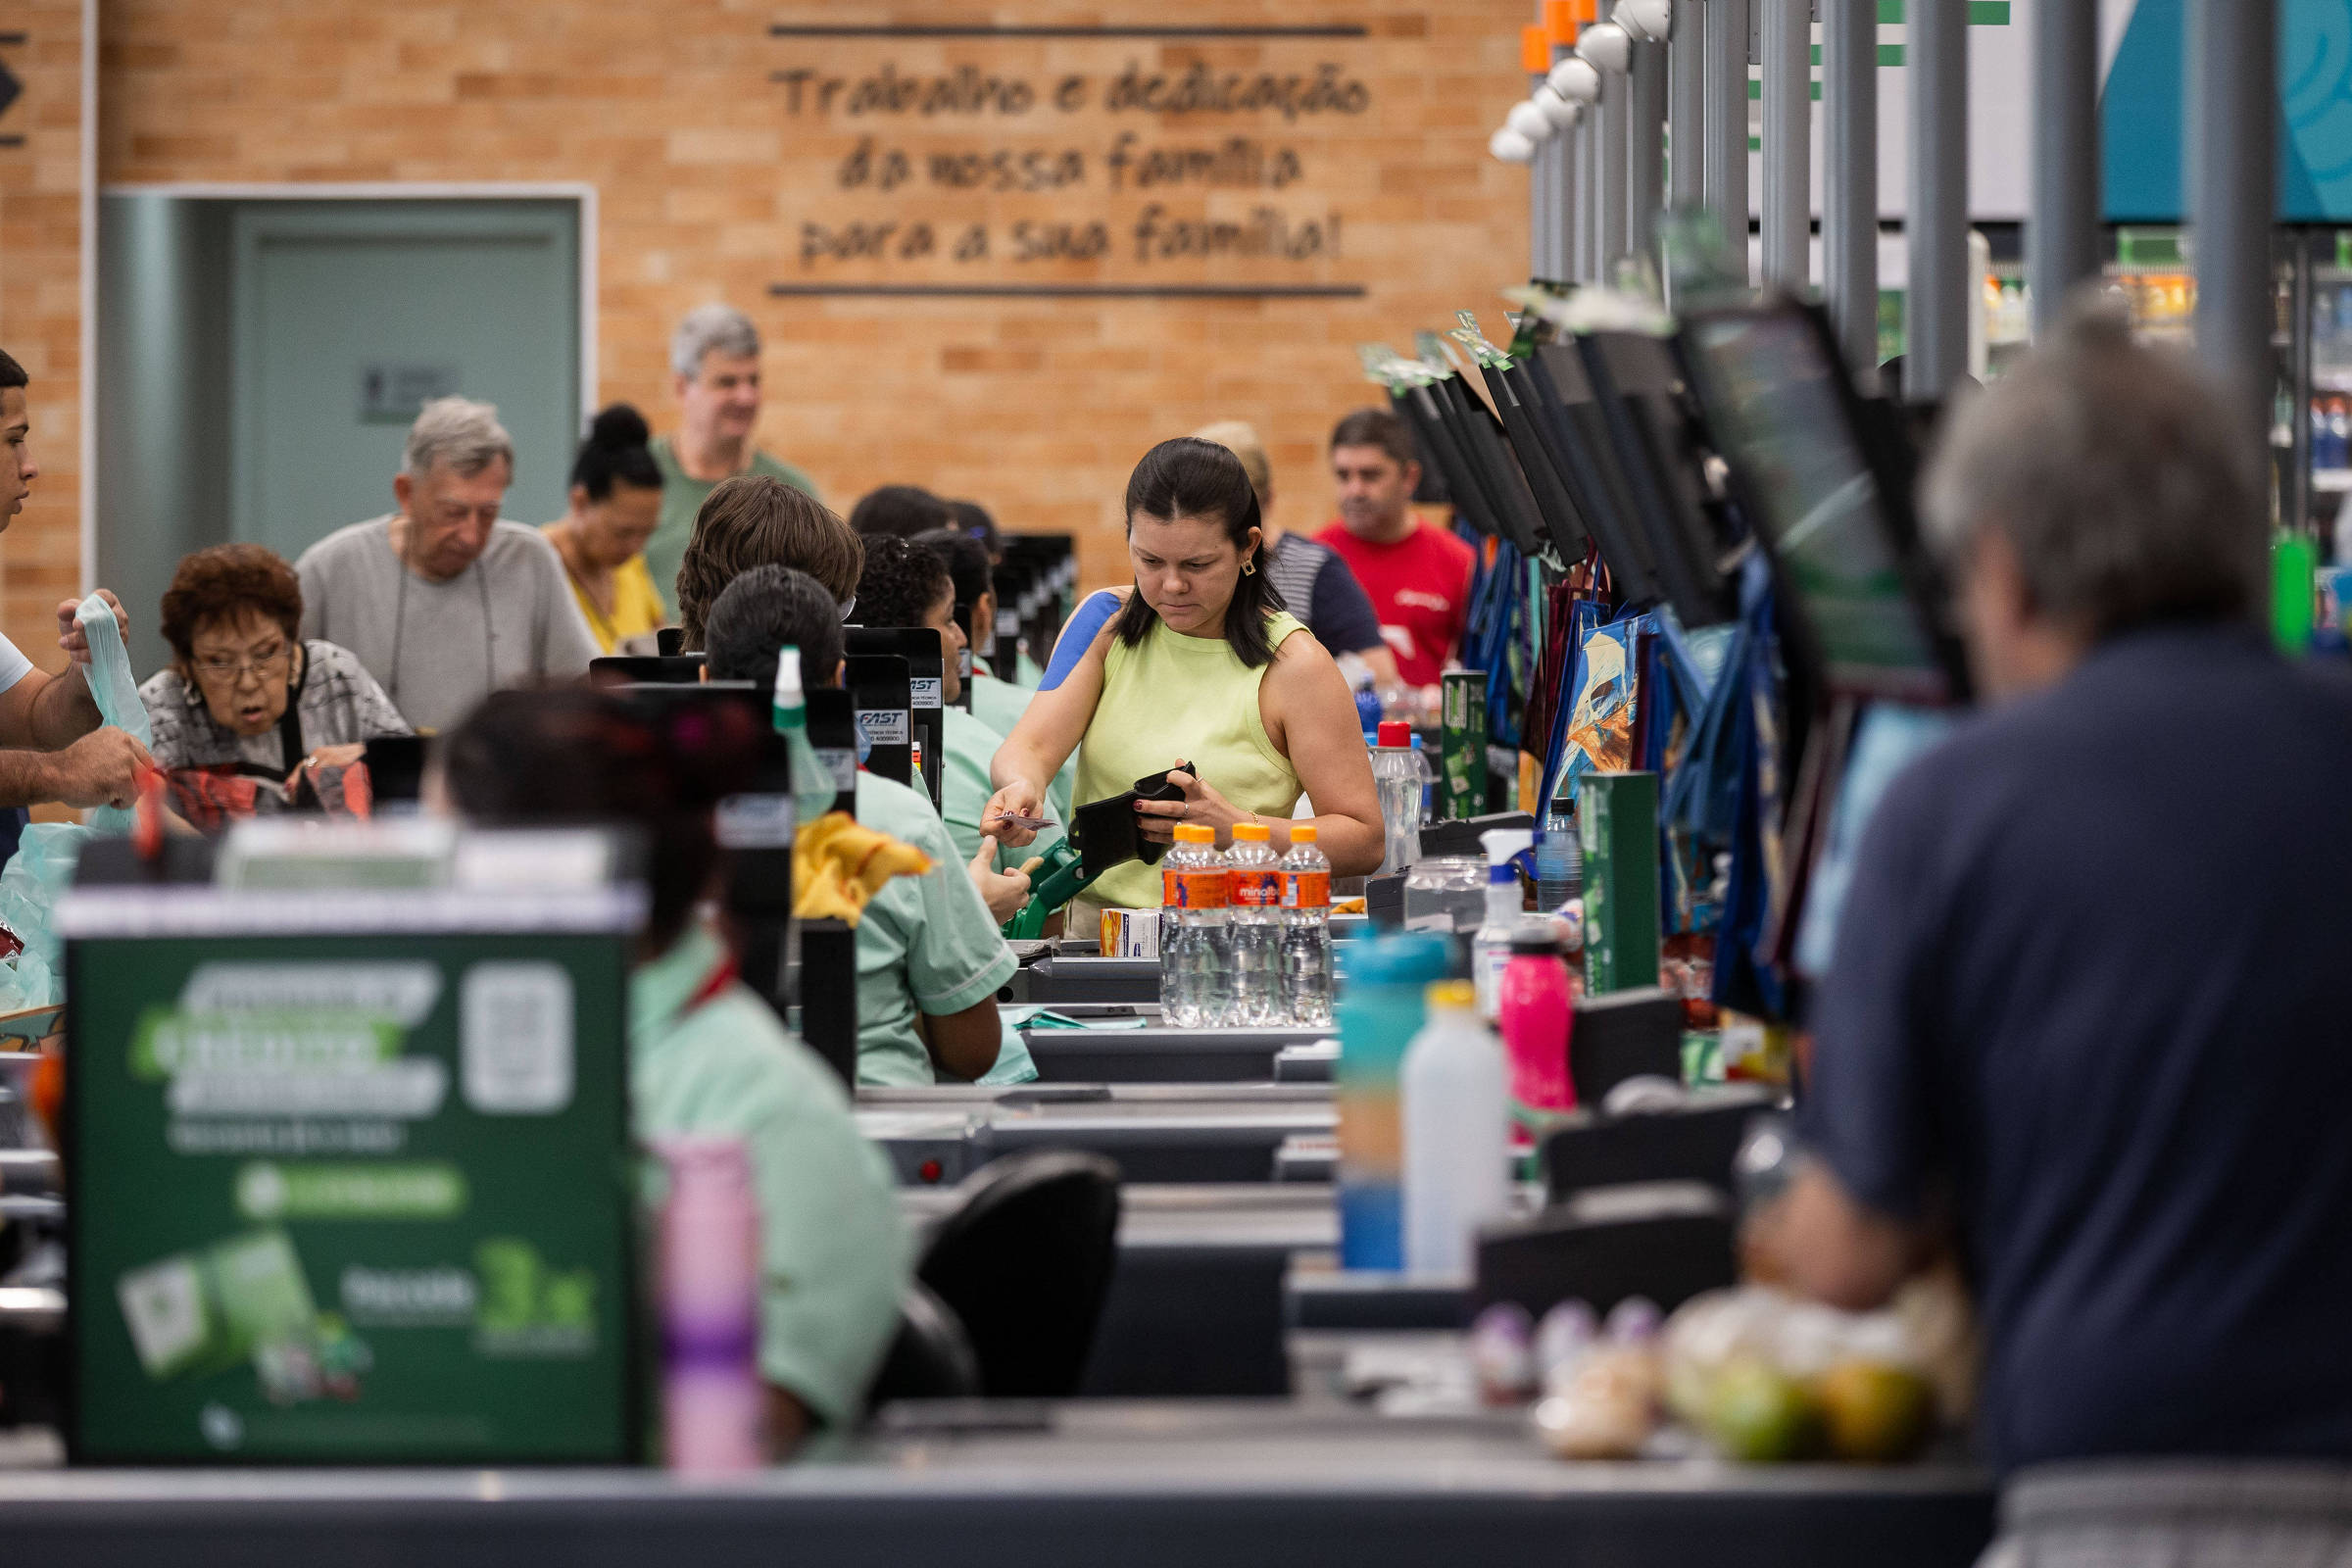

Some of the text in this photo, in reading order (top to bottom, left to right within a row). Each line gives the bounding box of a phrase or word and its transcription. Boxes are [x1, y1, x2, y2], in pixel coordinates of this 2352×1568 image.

[771, 59, 1370, 121] Trabalho e dedicação
[840, 133, 1303, 192] da nossa família
[799, 205, 1341, 267] para a sua família!
[859, 712, 903, 724] FAST
